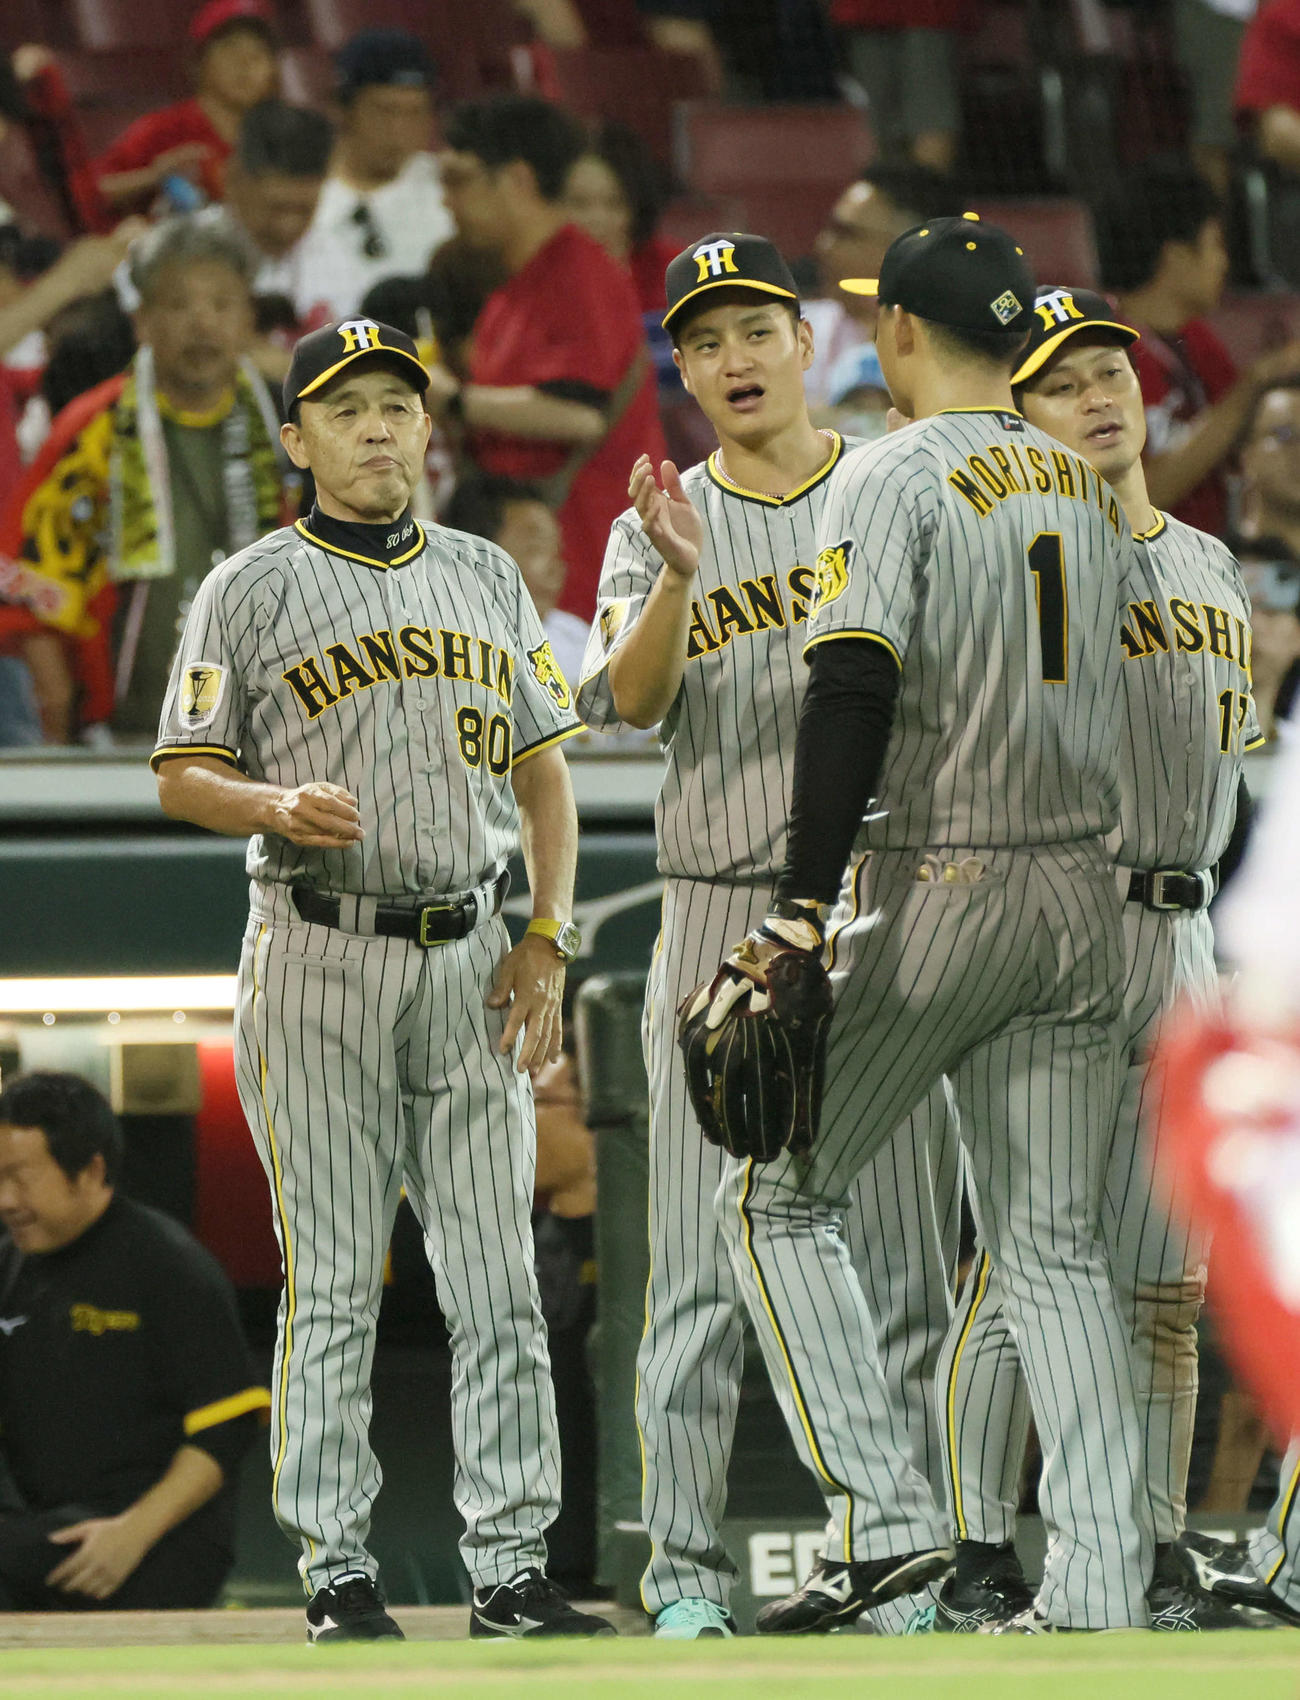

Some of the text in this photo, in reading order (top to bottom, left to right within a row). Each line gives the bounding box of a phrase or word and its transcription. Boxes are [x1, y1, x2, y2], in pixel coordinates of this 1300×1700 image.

[1027, 531, 1068, 684] 1
[282, 625, 515, 720] HANSHIN
[455, 706, 512, 777] 80
